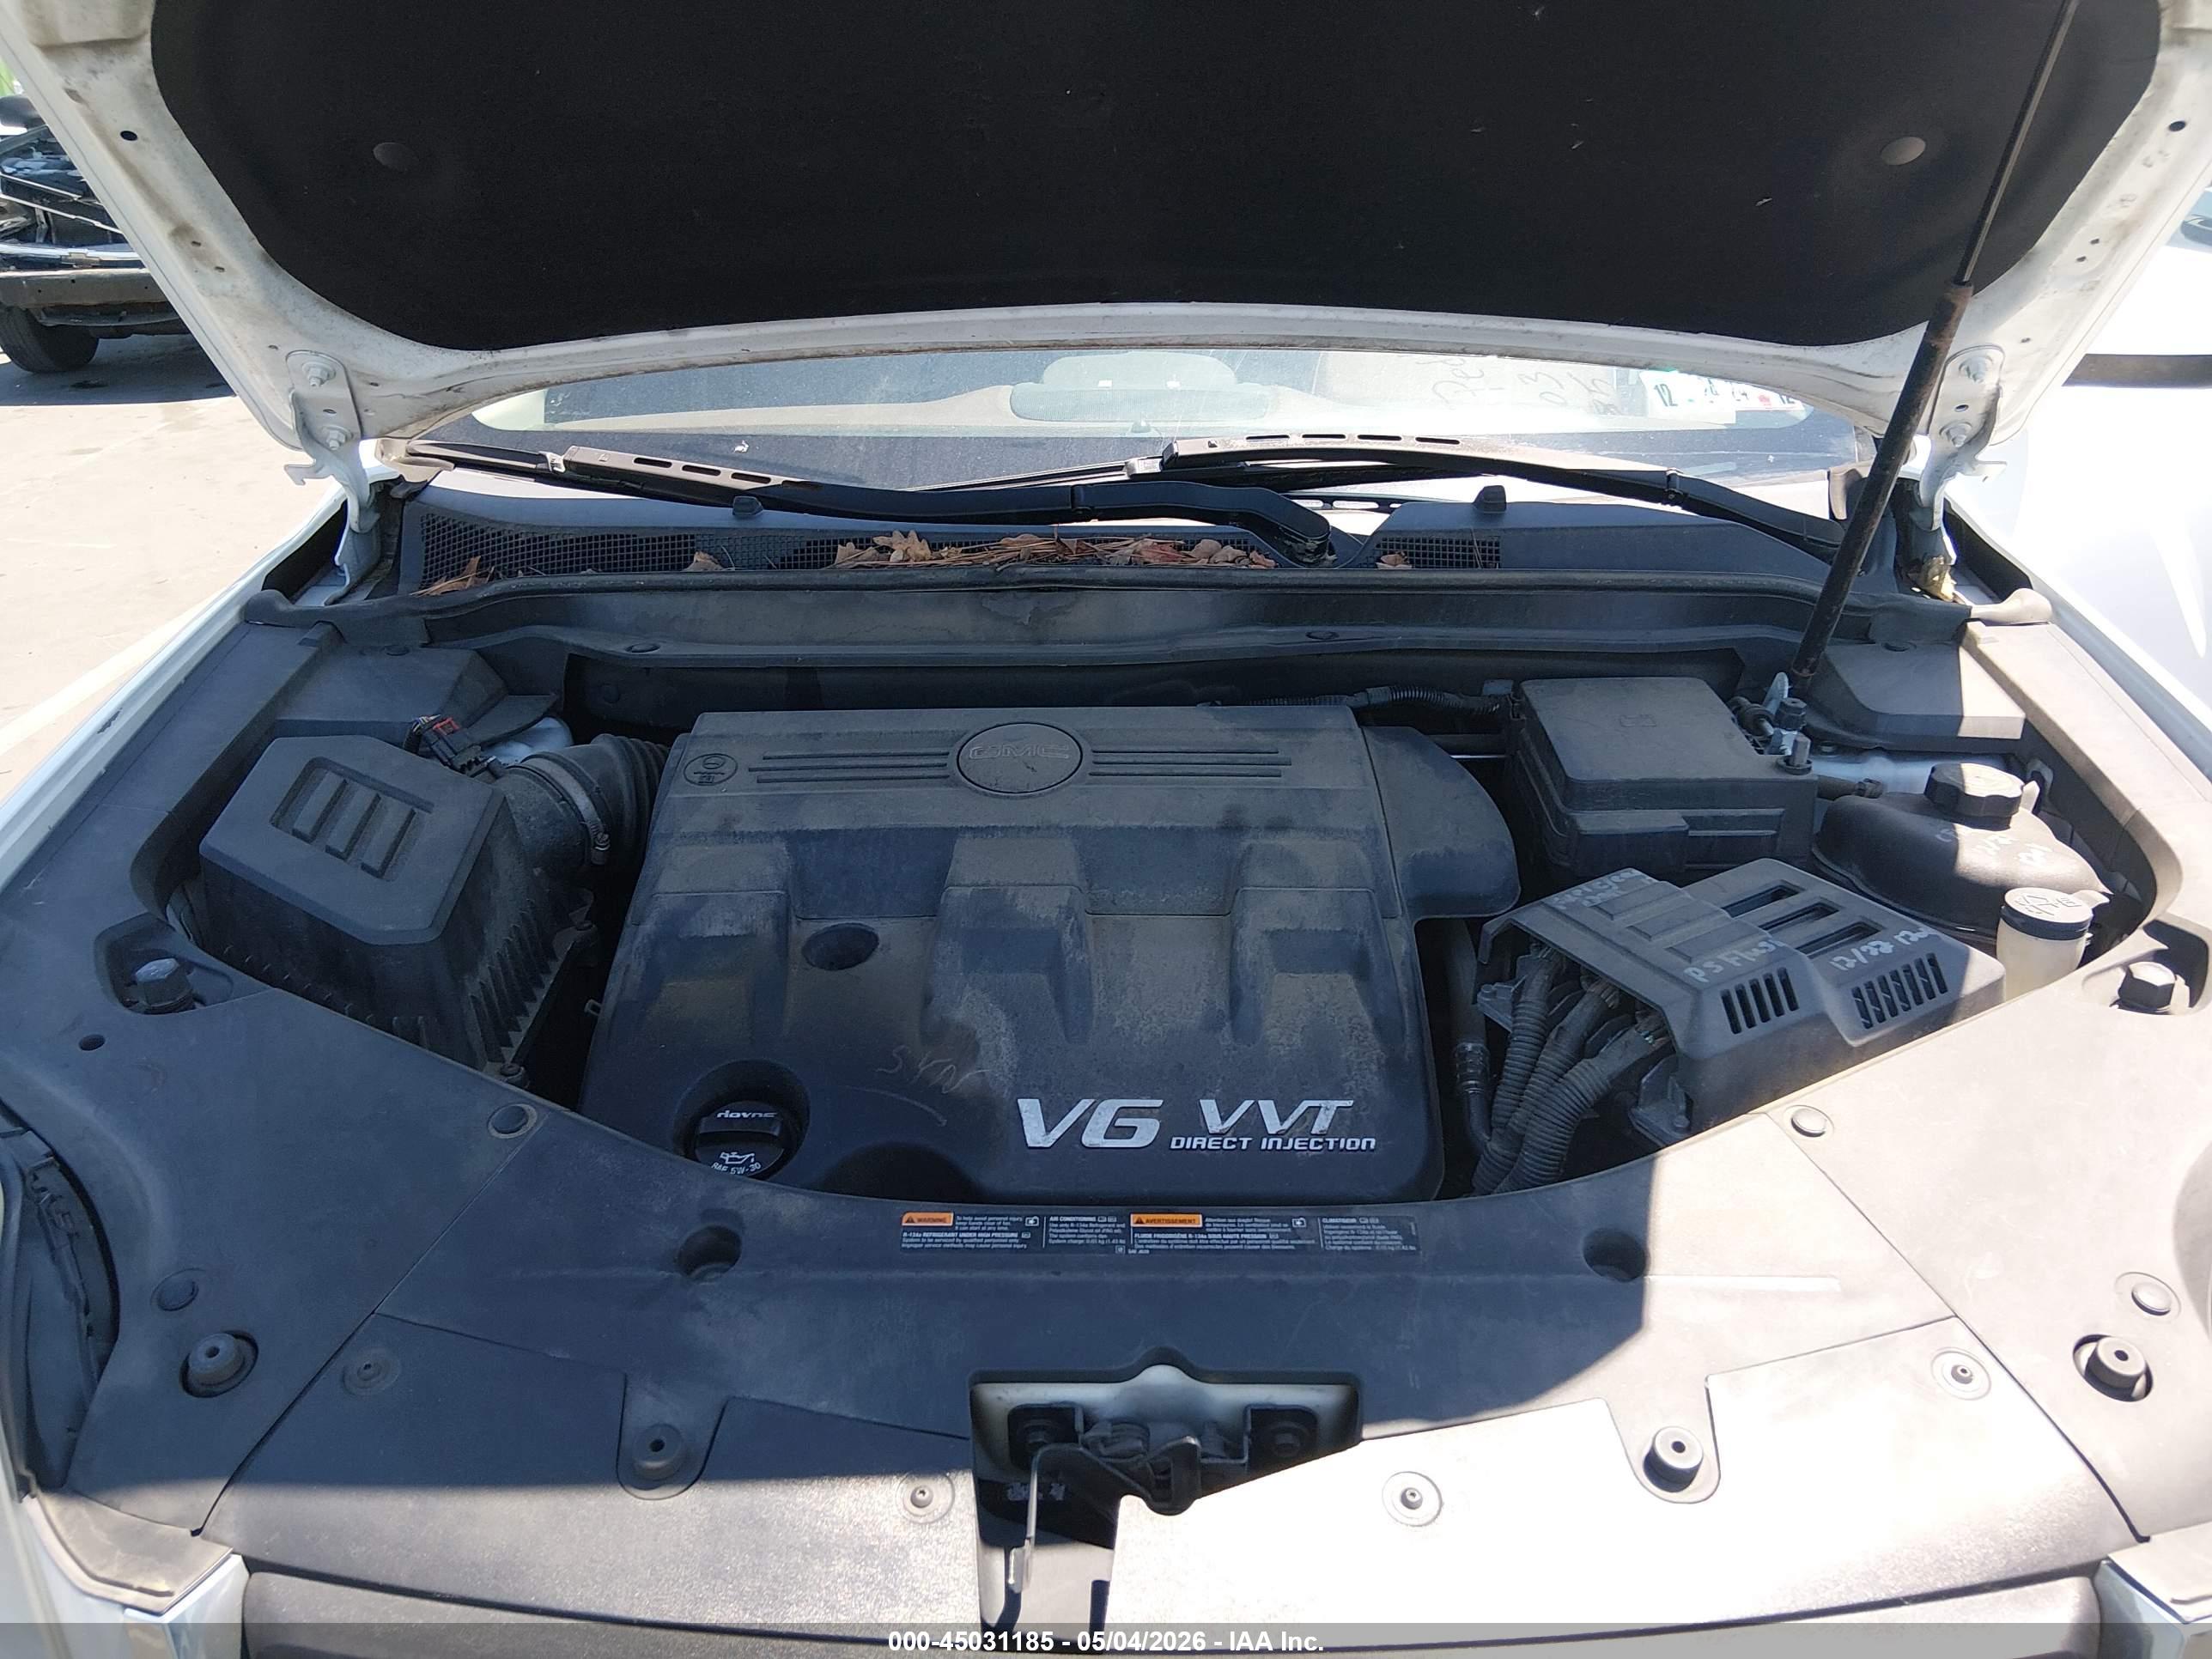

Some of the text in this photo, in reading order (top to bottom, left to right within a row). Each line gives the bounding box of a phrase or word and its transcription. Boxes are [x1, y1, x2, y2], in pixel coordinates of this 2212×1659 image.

[969, 743, 1069, 760] GMC
[1018, 1098, 1355, 1148] V6 VVT
[1170, 1136, 1376, 1152] DIRECT INJECTION
